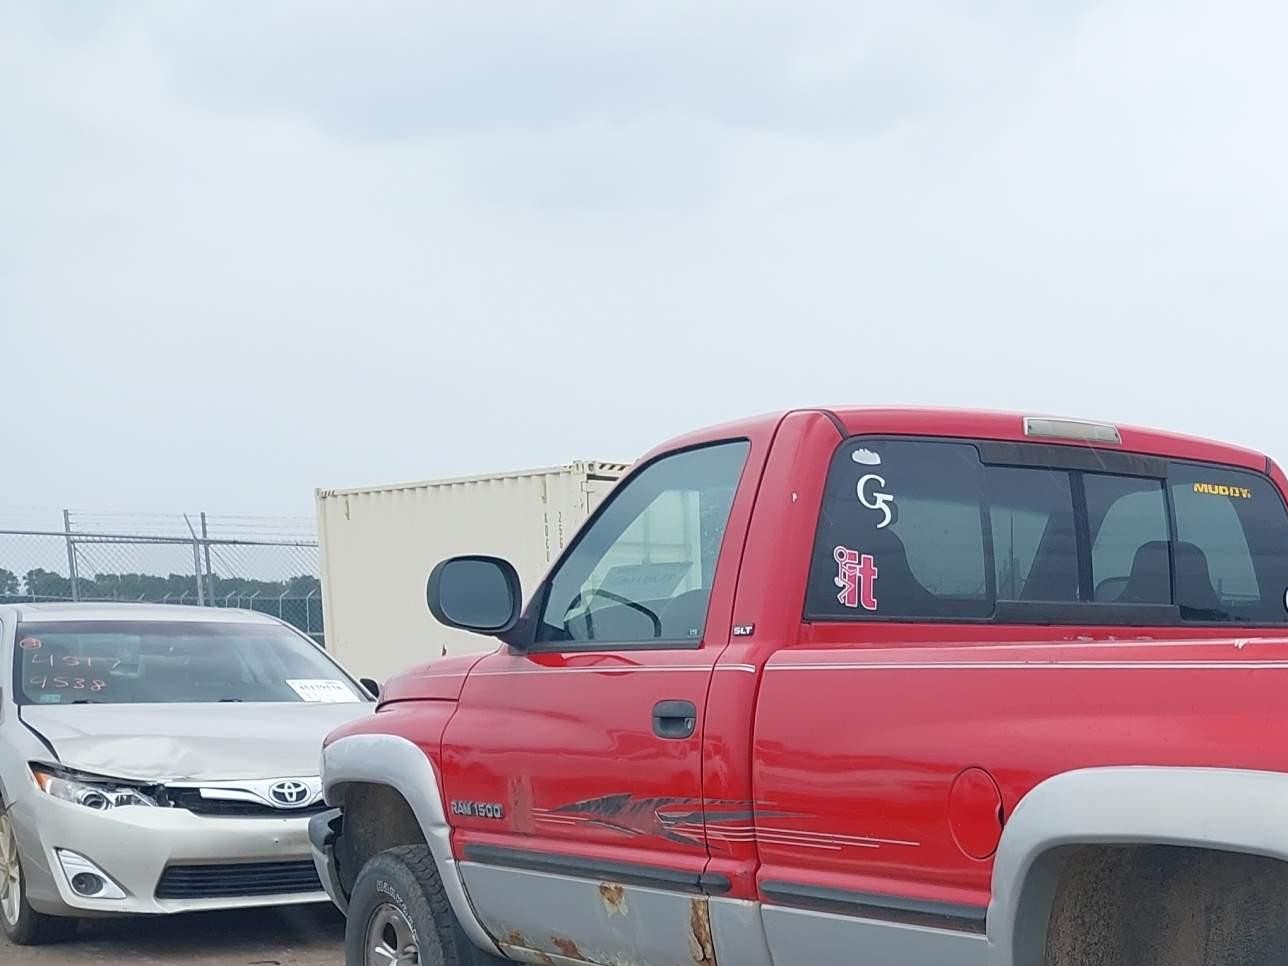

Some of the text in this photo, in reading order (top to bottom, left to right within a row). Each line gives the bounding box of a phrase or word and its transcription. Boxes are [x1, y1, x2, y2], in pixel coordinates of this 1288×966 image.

[733, 626, 753, 635] SLT
[451, 800, 504, 819] RAM 1500
